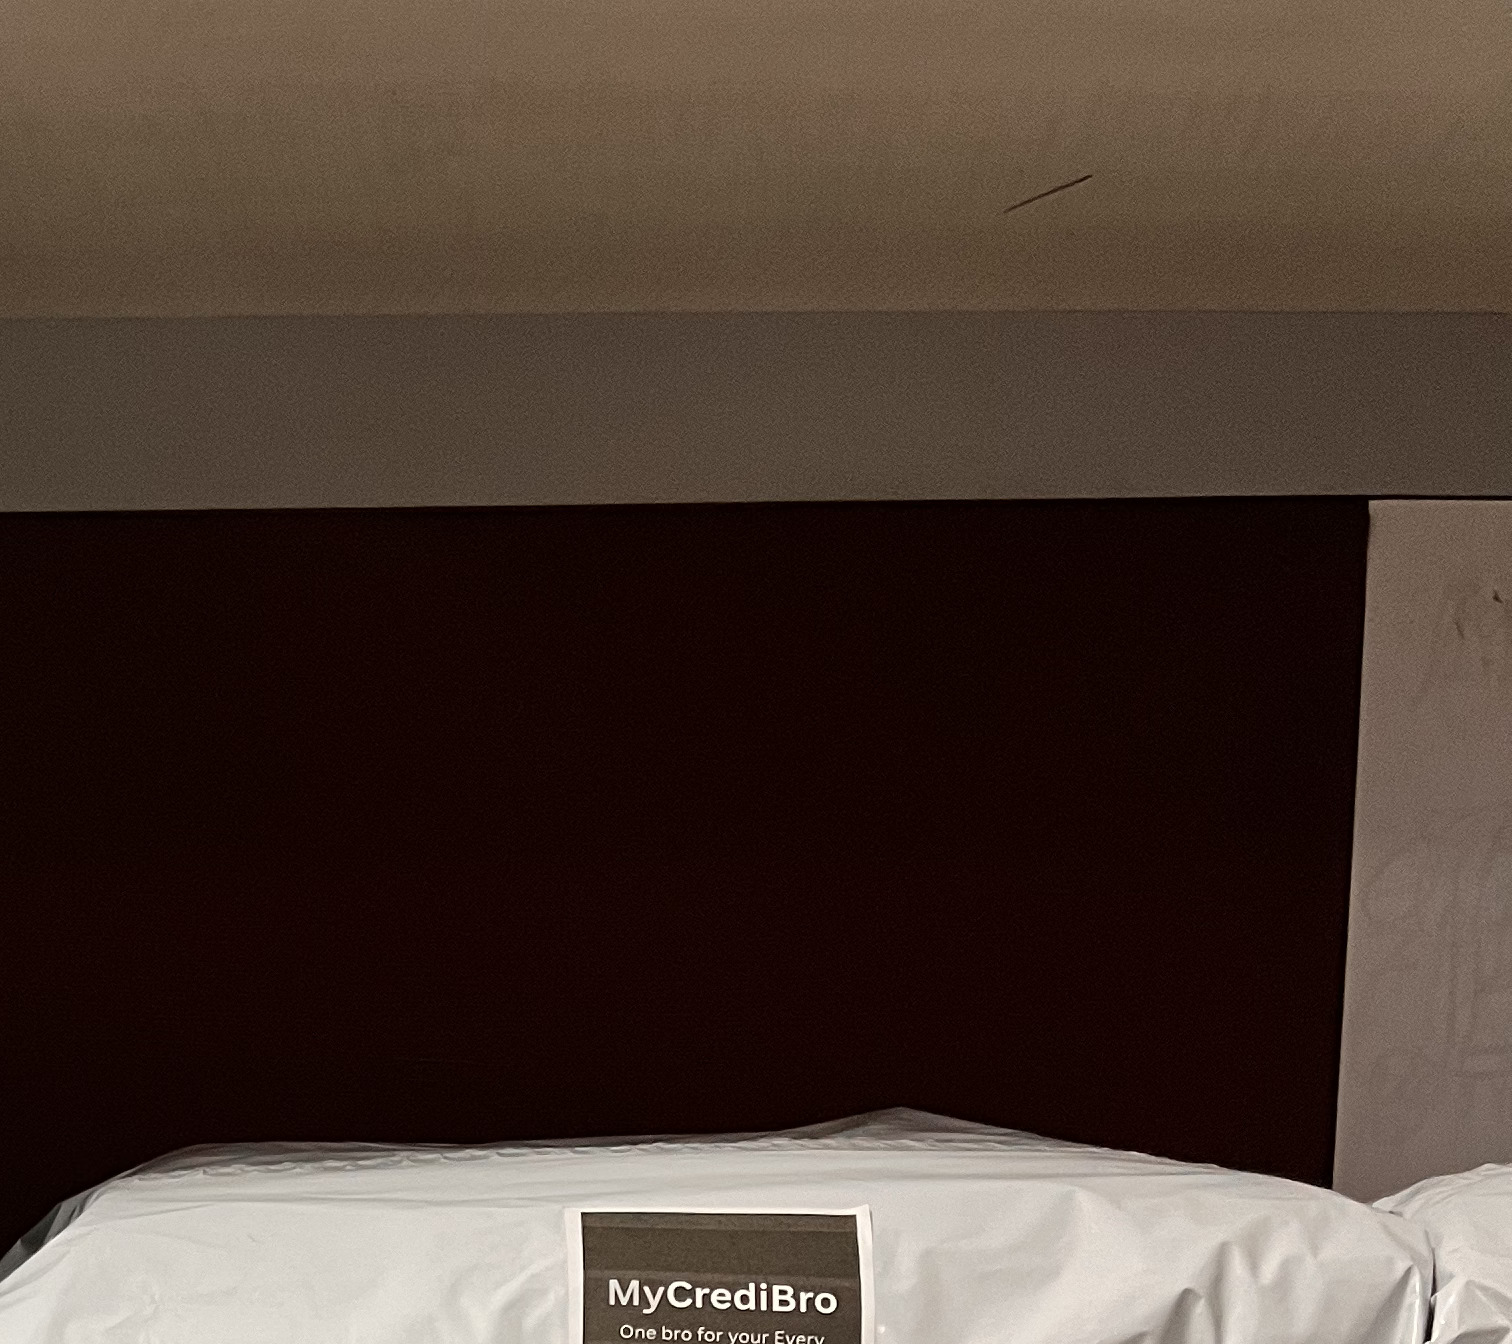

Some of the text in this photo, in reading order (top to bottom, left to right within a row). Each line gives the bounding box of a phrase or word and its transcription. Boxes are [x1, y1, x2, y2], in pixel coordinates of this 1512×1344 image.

[607, 1278, 839, 1315] MyCrediBro
[619, 1324, 657, 1340] One
[660, 1326, 693, 1342] bro
[696, 1326, 724, 1343] for
